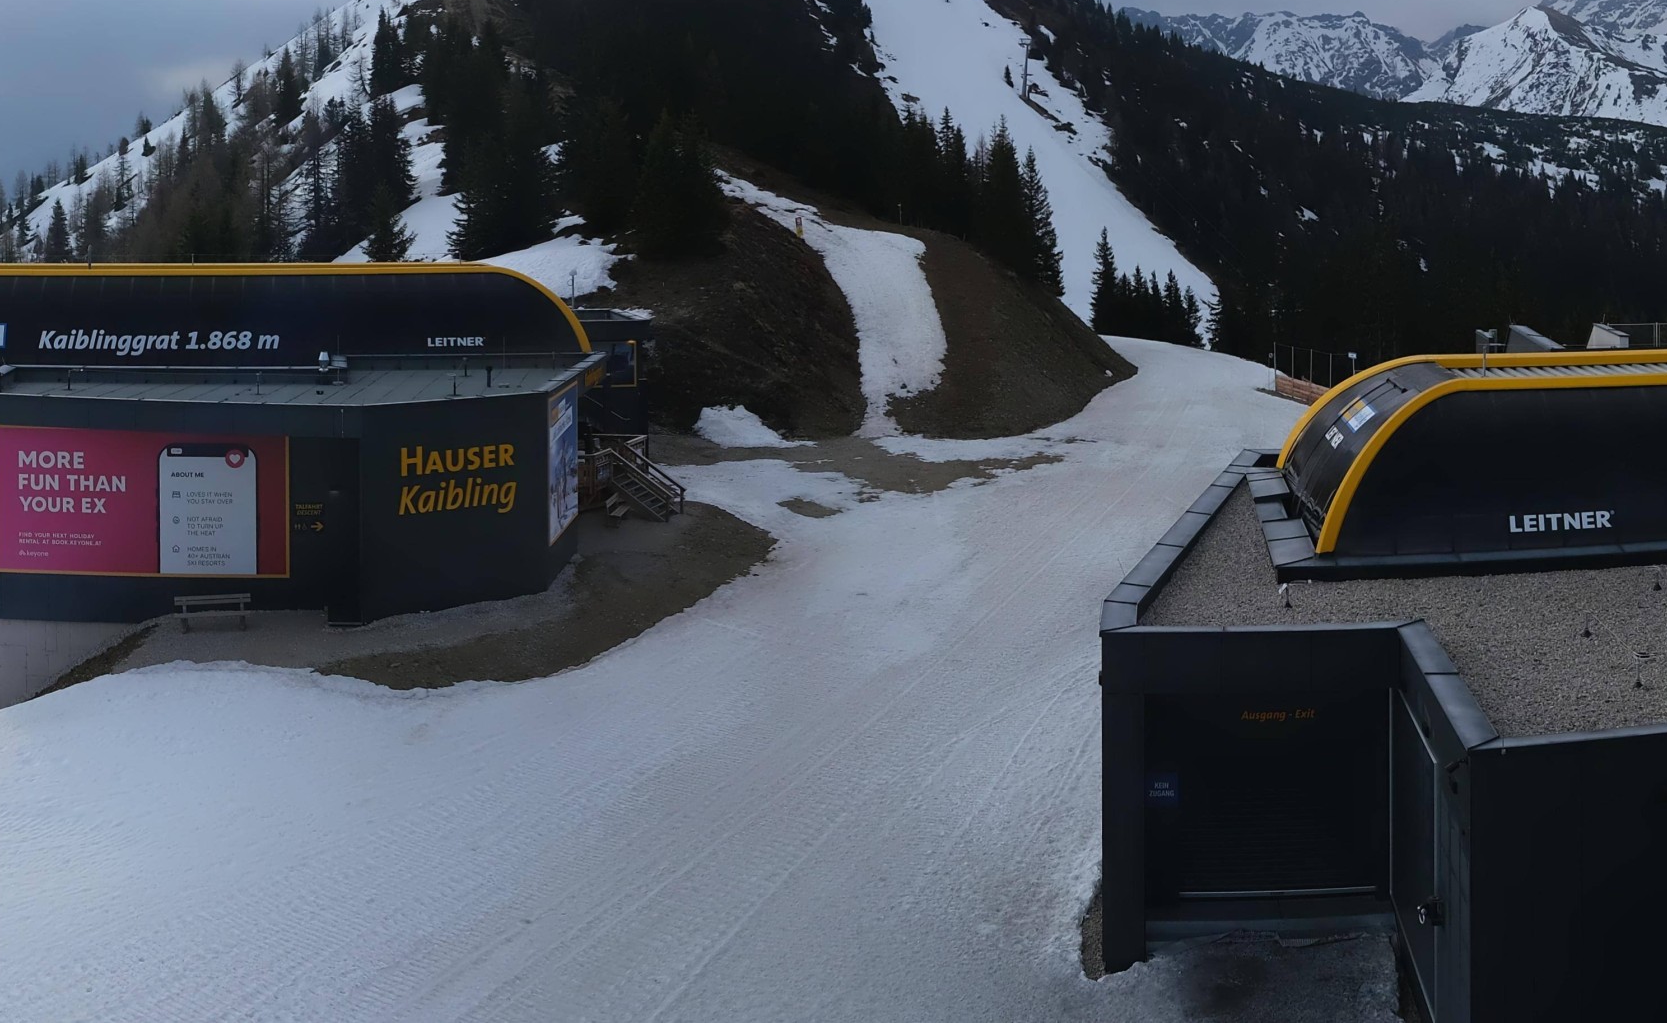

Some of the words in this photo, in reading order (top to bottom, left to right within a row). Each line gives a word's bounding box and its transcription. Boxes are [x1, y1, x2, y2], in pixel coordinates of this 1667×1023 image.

[38, 329, 180, 356] Kaiblinggrat
[185, 331, 252, 350] 1.868
[257, 334, 280, 350] m
[427, 336, 484, 347] LEITNER
[18, 450, 85, 469] MORE
[400, 443, 515, 477] HAUSER
[18, 474, 59, 490] FUN
[66, 474, 126, 492] THAN
[19, 496, 75, 513] YOUR
[81, 497, 107, 513] EX
[398, 477, 517, 515] Kaibling
[1509, 510, 1613, 532] LEITNER
[26, 550, 49, 558] keyone
[1241, 710, 1286, 722] Ausgang
[1295, 708, 1316, 719] Exit
[1149, 789, 1175, 797] ZUGANG
